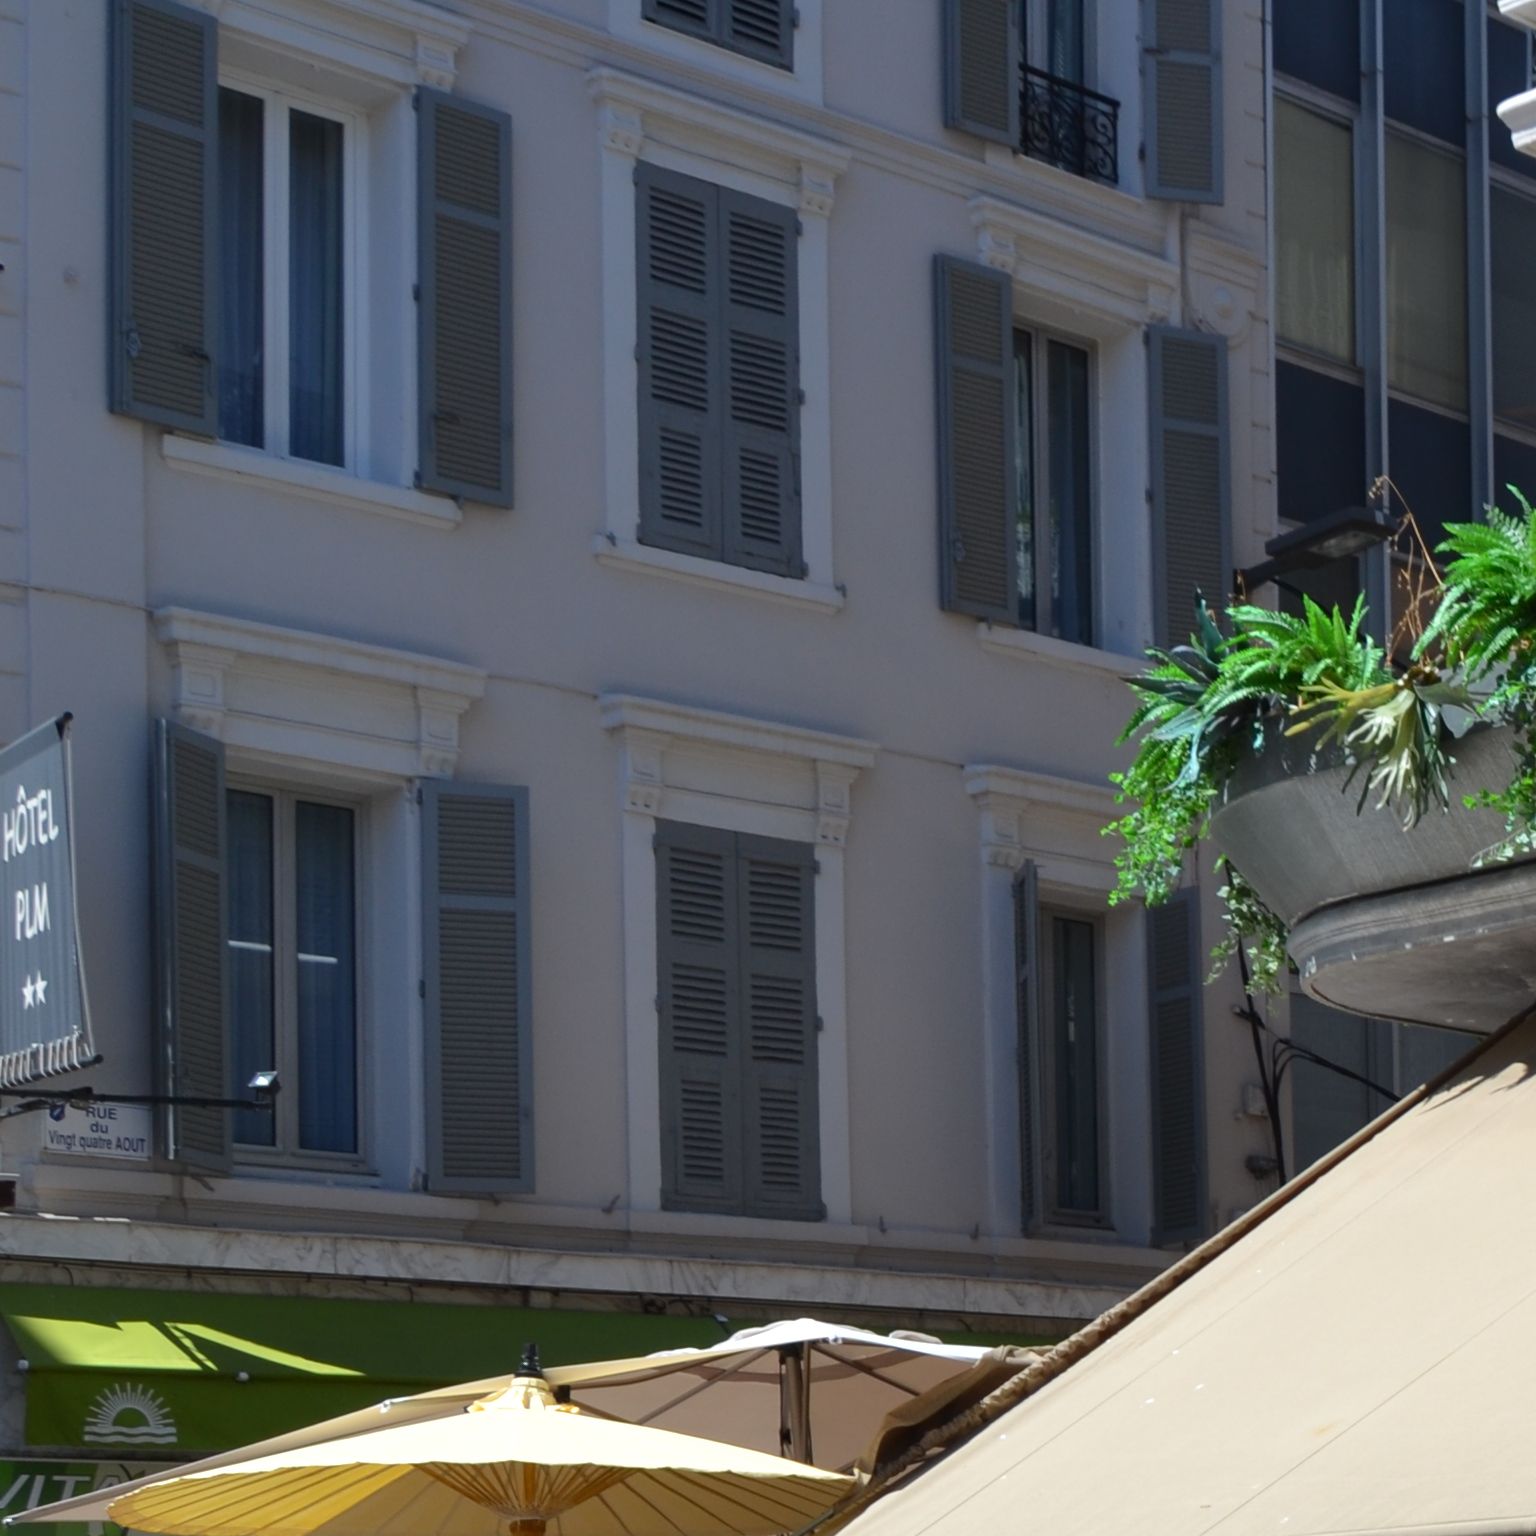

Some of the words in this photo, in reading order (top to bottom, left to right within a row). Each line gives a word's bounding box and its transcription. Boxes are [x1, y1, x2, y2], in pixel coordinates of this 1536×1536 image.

[3, 784, 60, 863] HÔTEL
[15, 882, 51, 941] PLM
[86, 1105, 119, 1121] RUE
[89, 1121, 109, 1135] du
[48, 1130, 77, 1151] Vingt
[79, 1135, 113, 1153] quatre
[115, 1136, 148, 1154] AOUT
